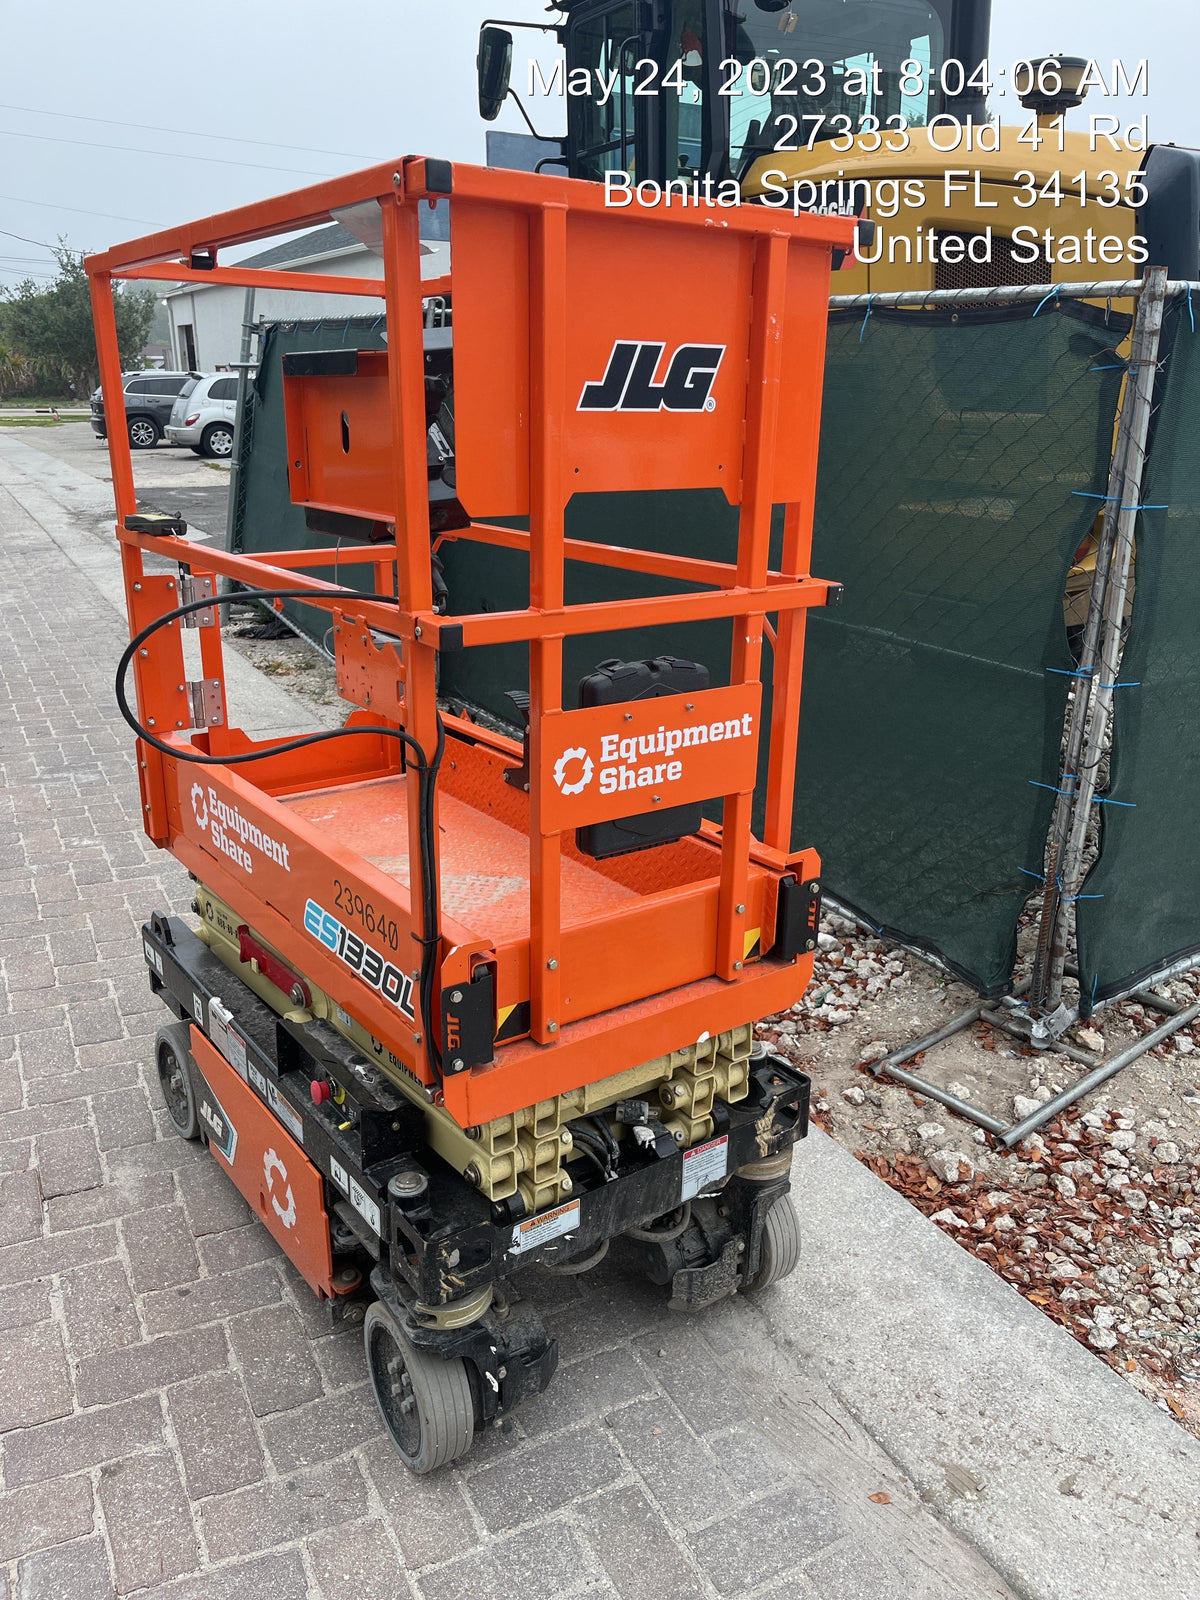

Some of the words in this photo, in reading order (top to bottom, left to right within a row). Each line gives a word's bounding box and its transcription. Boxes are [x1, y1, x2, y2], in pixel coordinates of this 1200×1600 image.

[600, 713, 753, 764] Equipment
[599, 760, 682, 795] Share
[208, 786, 291, 872] Equipment
[211, 820, 253, 874] Share
[334, 879, 400, 951] 239640
[304, 897, 416, 1023] ES1330L
[446, 1012, 460, 1052] JLG
[200, 1101, 224, 1138] JLG
[537, 1205, 570, 1223] WARNING
